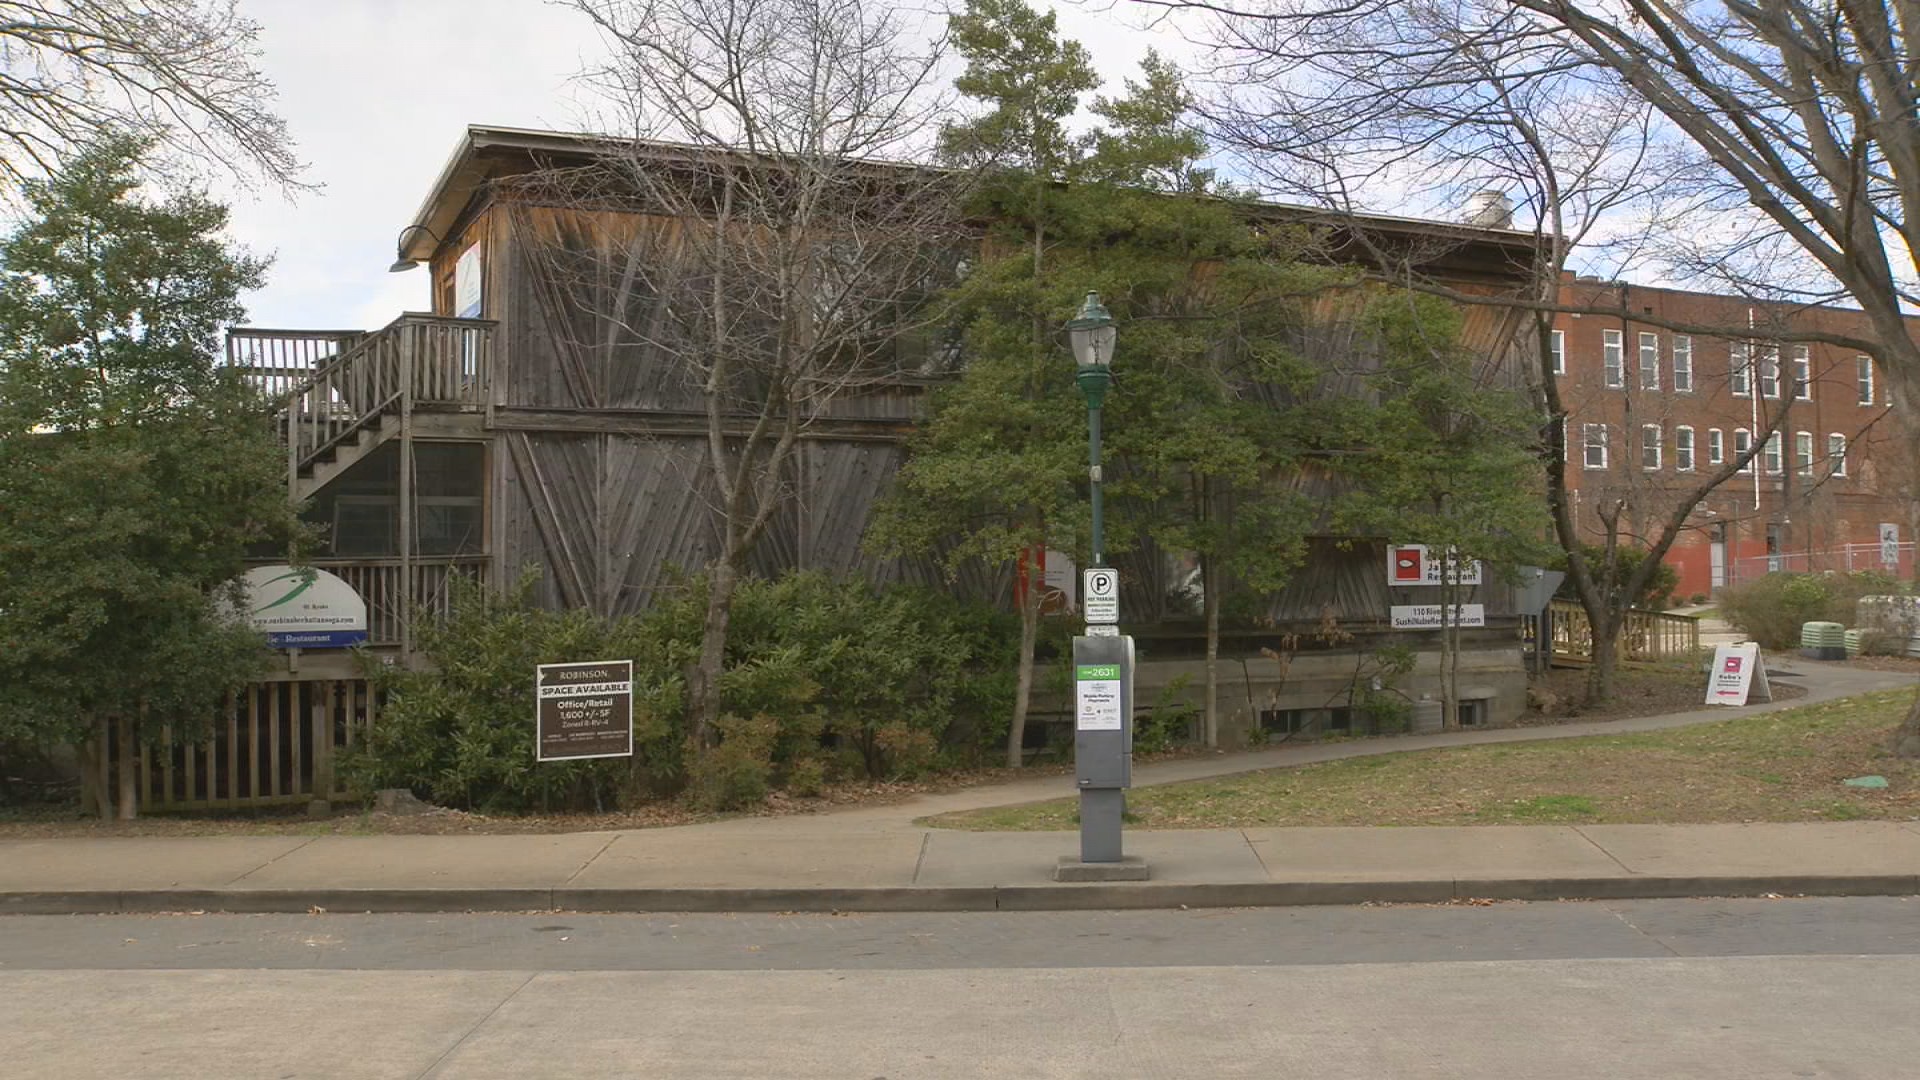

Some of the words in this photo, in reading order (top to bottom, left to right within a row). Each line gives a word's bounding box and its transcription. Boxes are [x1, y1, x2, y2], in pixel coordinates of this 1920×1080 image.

[1427, 573, 1477, 581] Reauant
[1096, 577, 1108, 591] P
[285, 634, 331, 643] Restaurant
[559, 670, 608, 680] ROBINSON
[1091, 668, 1114, 677] 2631
[542, 687, 573, 696] SPACE
[575, 684, 629, 693] AVAILABLE
[557, 698, 613, 709] Office/Retail
